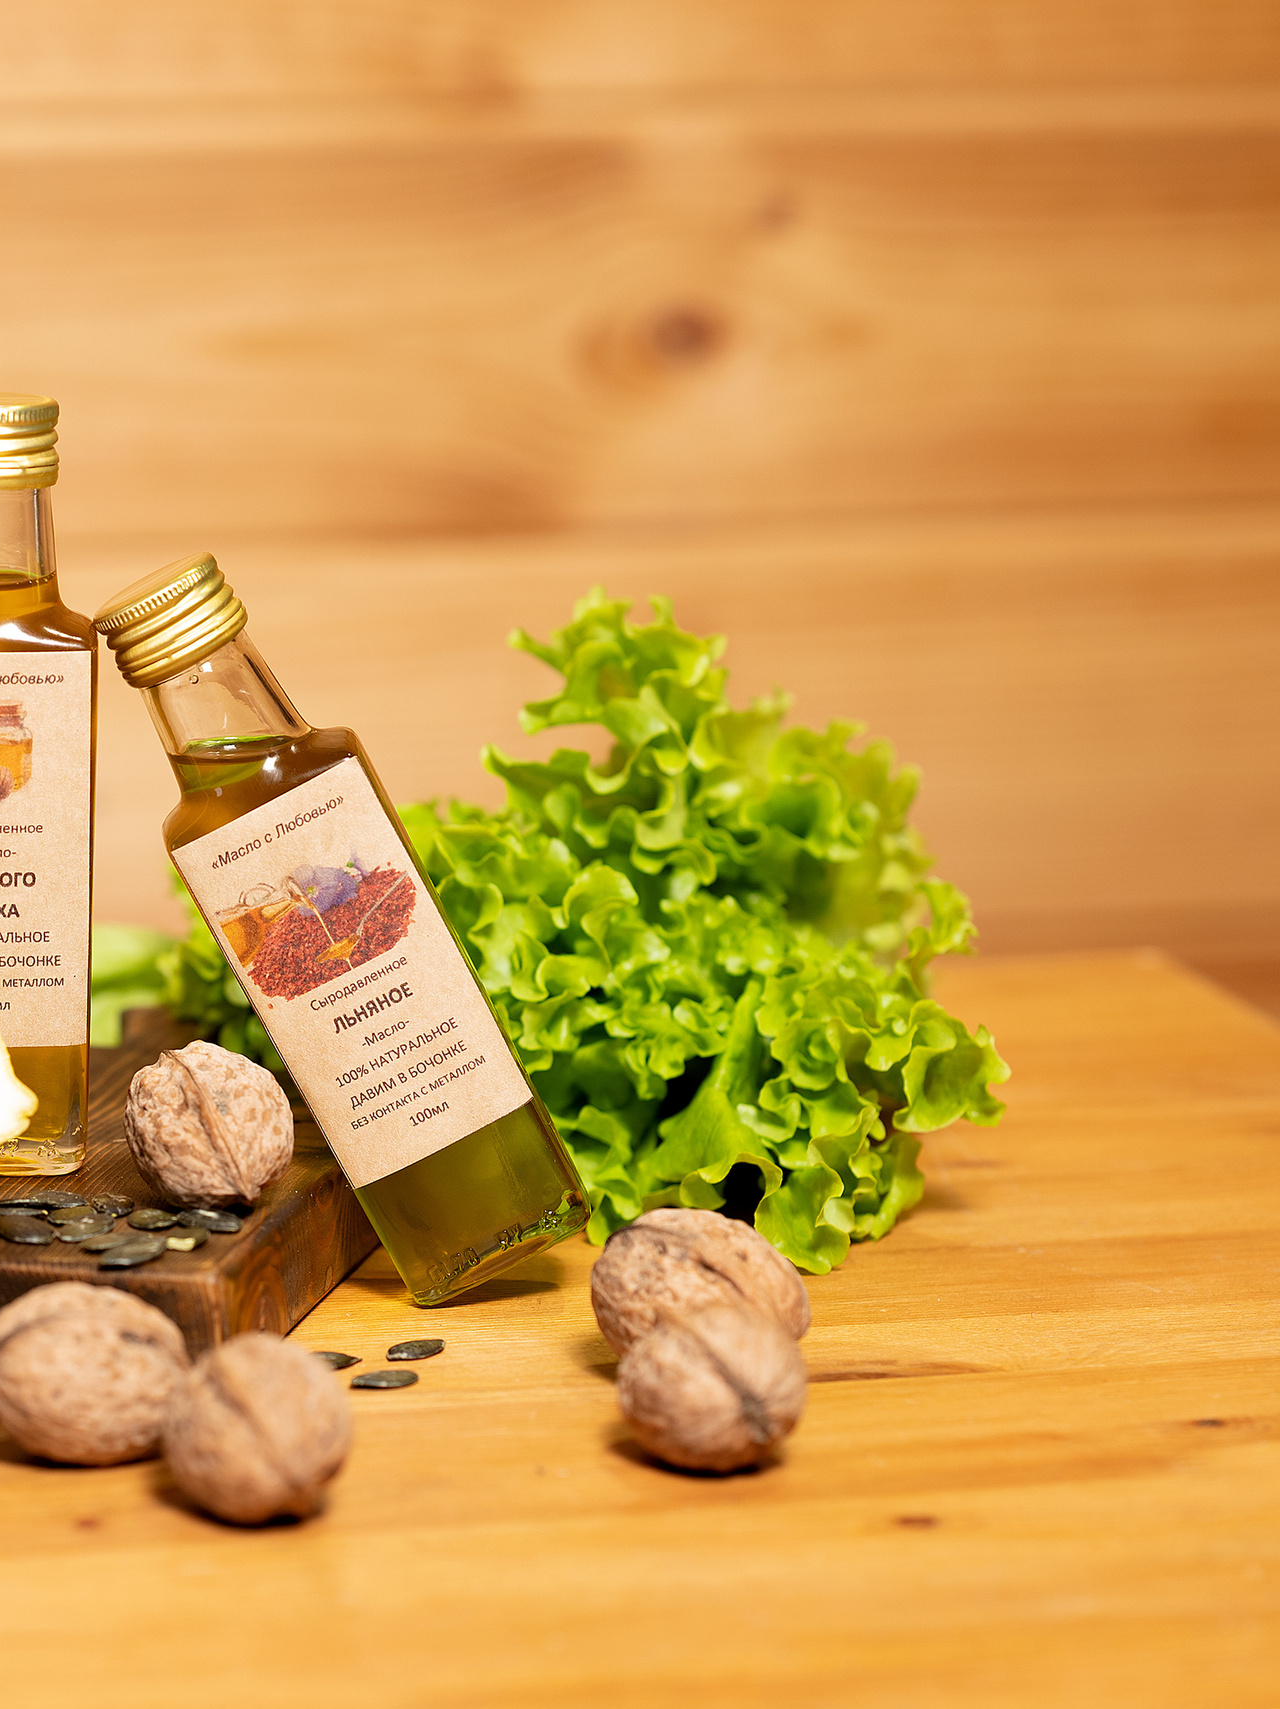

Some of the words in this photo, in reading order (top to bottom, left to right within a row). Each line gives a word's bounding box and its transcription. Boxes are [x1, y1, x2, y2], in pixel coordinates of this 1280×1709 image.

[211, 837, 262, 870] «Масло
[264, 832, 272, 843] с
[276, 795, 344, 838] Любовью»
[2, 977, 65, 988] МЕТАЛЛОМ
[310, 955, 408, 1011] Сыродавленное
[333, 981, 414, 1034] ЛЬНЯНОЕ
[335, 1063, 370, 1088] 100%
[369, 1017, 458, 1072] НАТУРАЛЬНОЕ
[361, 1019, 410, 1047] -Масло-
[350, 1076, 397, 1110] ДАВИМ
[397, 1071, 408, 1084] В
[408, 1039, 468, 1078] БОЧОНКЕ
[350, 1115, 370, 1131] БЕЗ
[369, 1090, 420, 1122] КОНТАКТА
[420, 1086, 428, 1095] С
[428, 1054, 487, 1092] МЕТАЛЛОМ
[409, 1100, 450, 1127] 100мл
